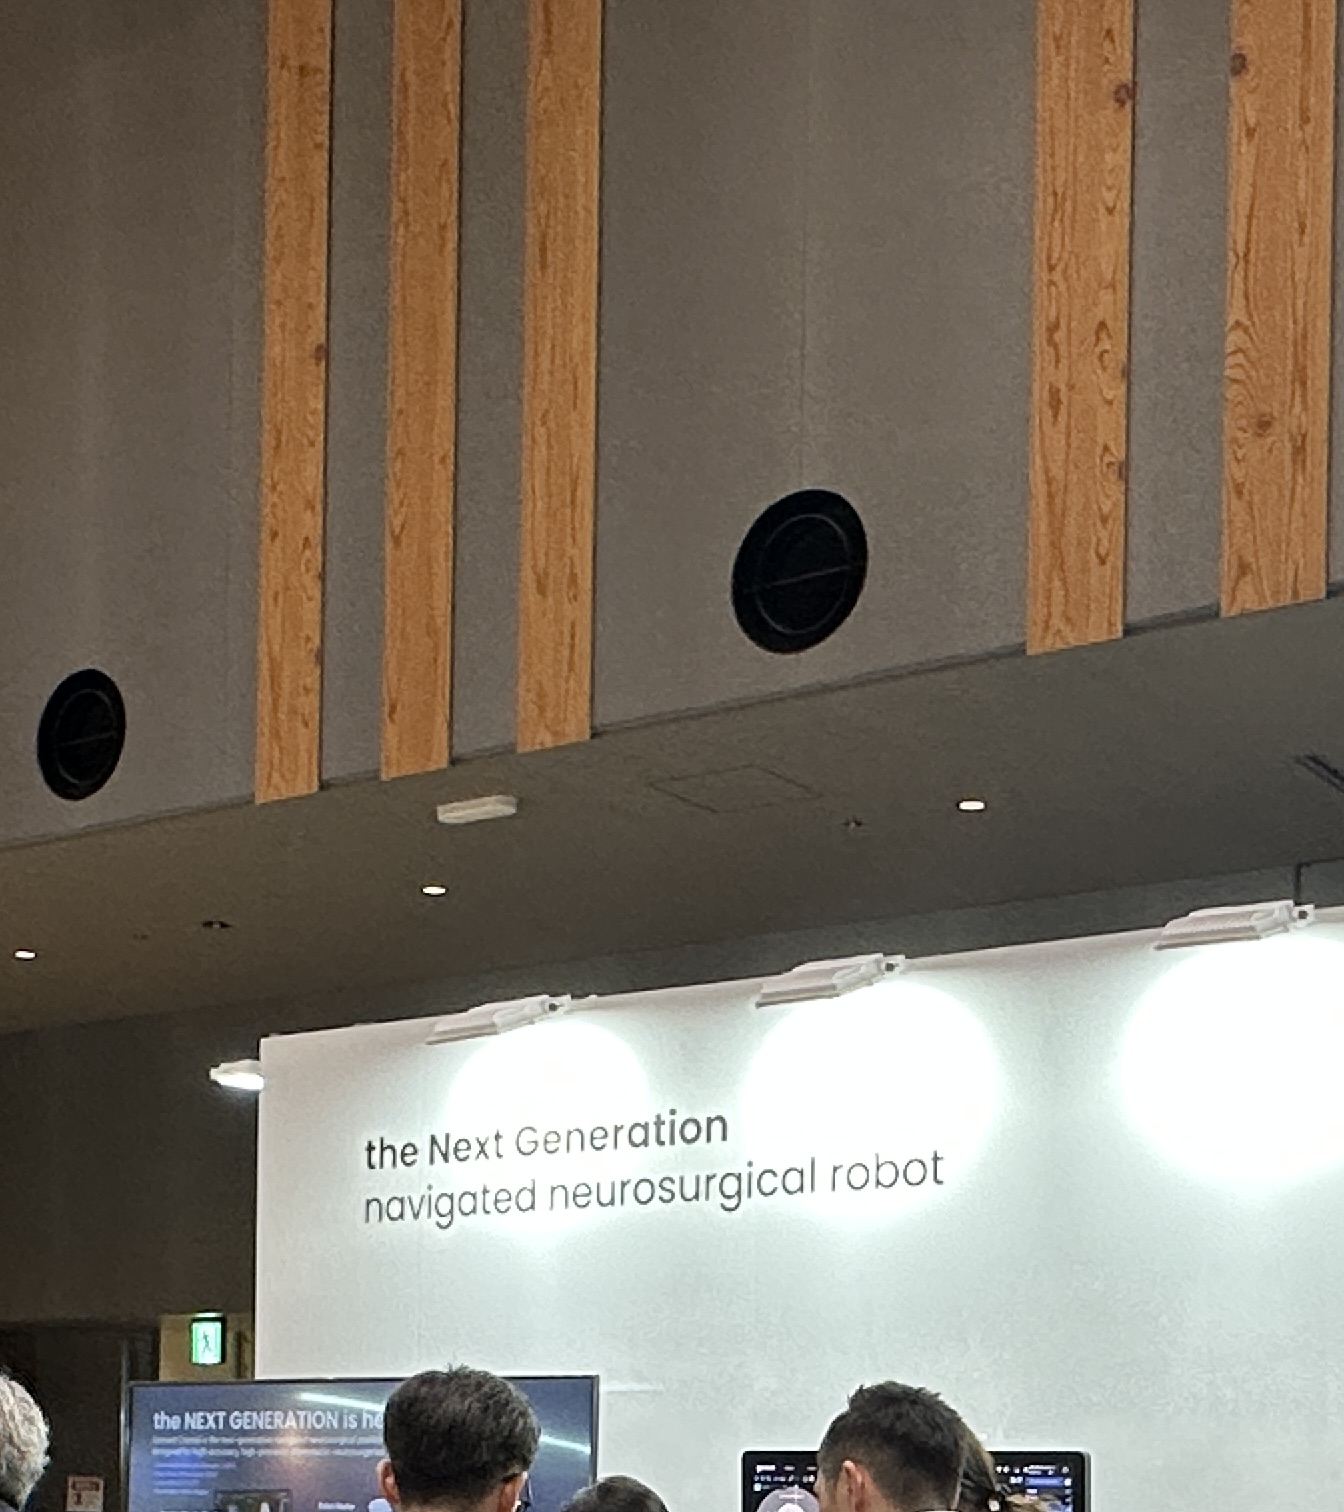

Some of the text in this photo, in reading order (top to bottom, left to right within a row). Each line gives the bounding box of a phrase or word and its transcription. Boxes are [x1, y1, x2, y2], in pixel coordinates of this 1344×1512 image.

[364, 1109, 729, 1171] the Next Generation
[364, 1149, 946, 1230] navigated neurosurgical robot
[153, 1411, 181, 1430] the
[184, 1411, 227, 1430] NEXT
[229, 1410, 338, 1430] GENERATION
[343, 1410, 358, 1430] is
